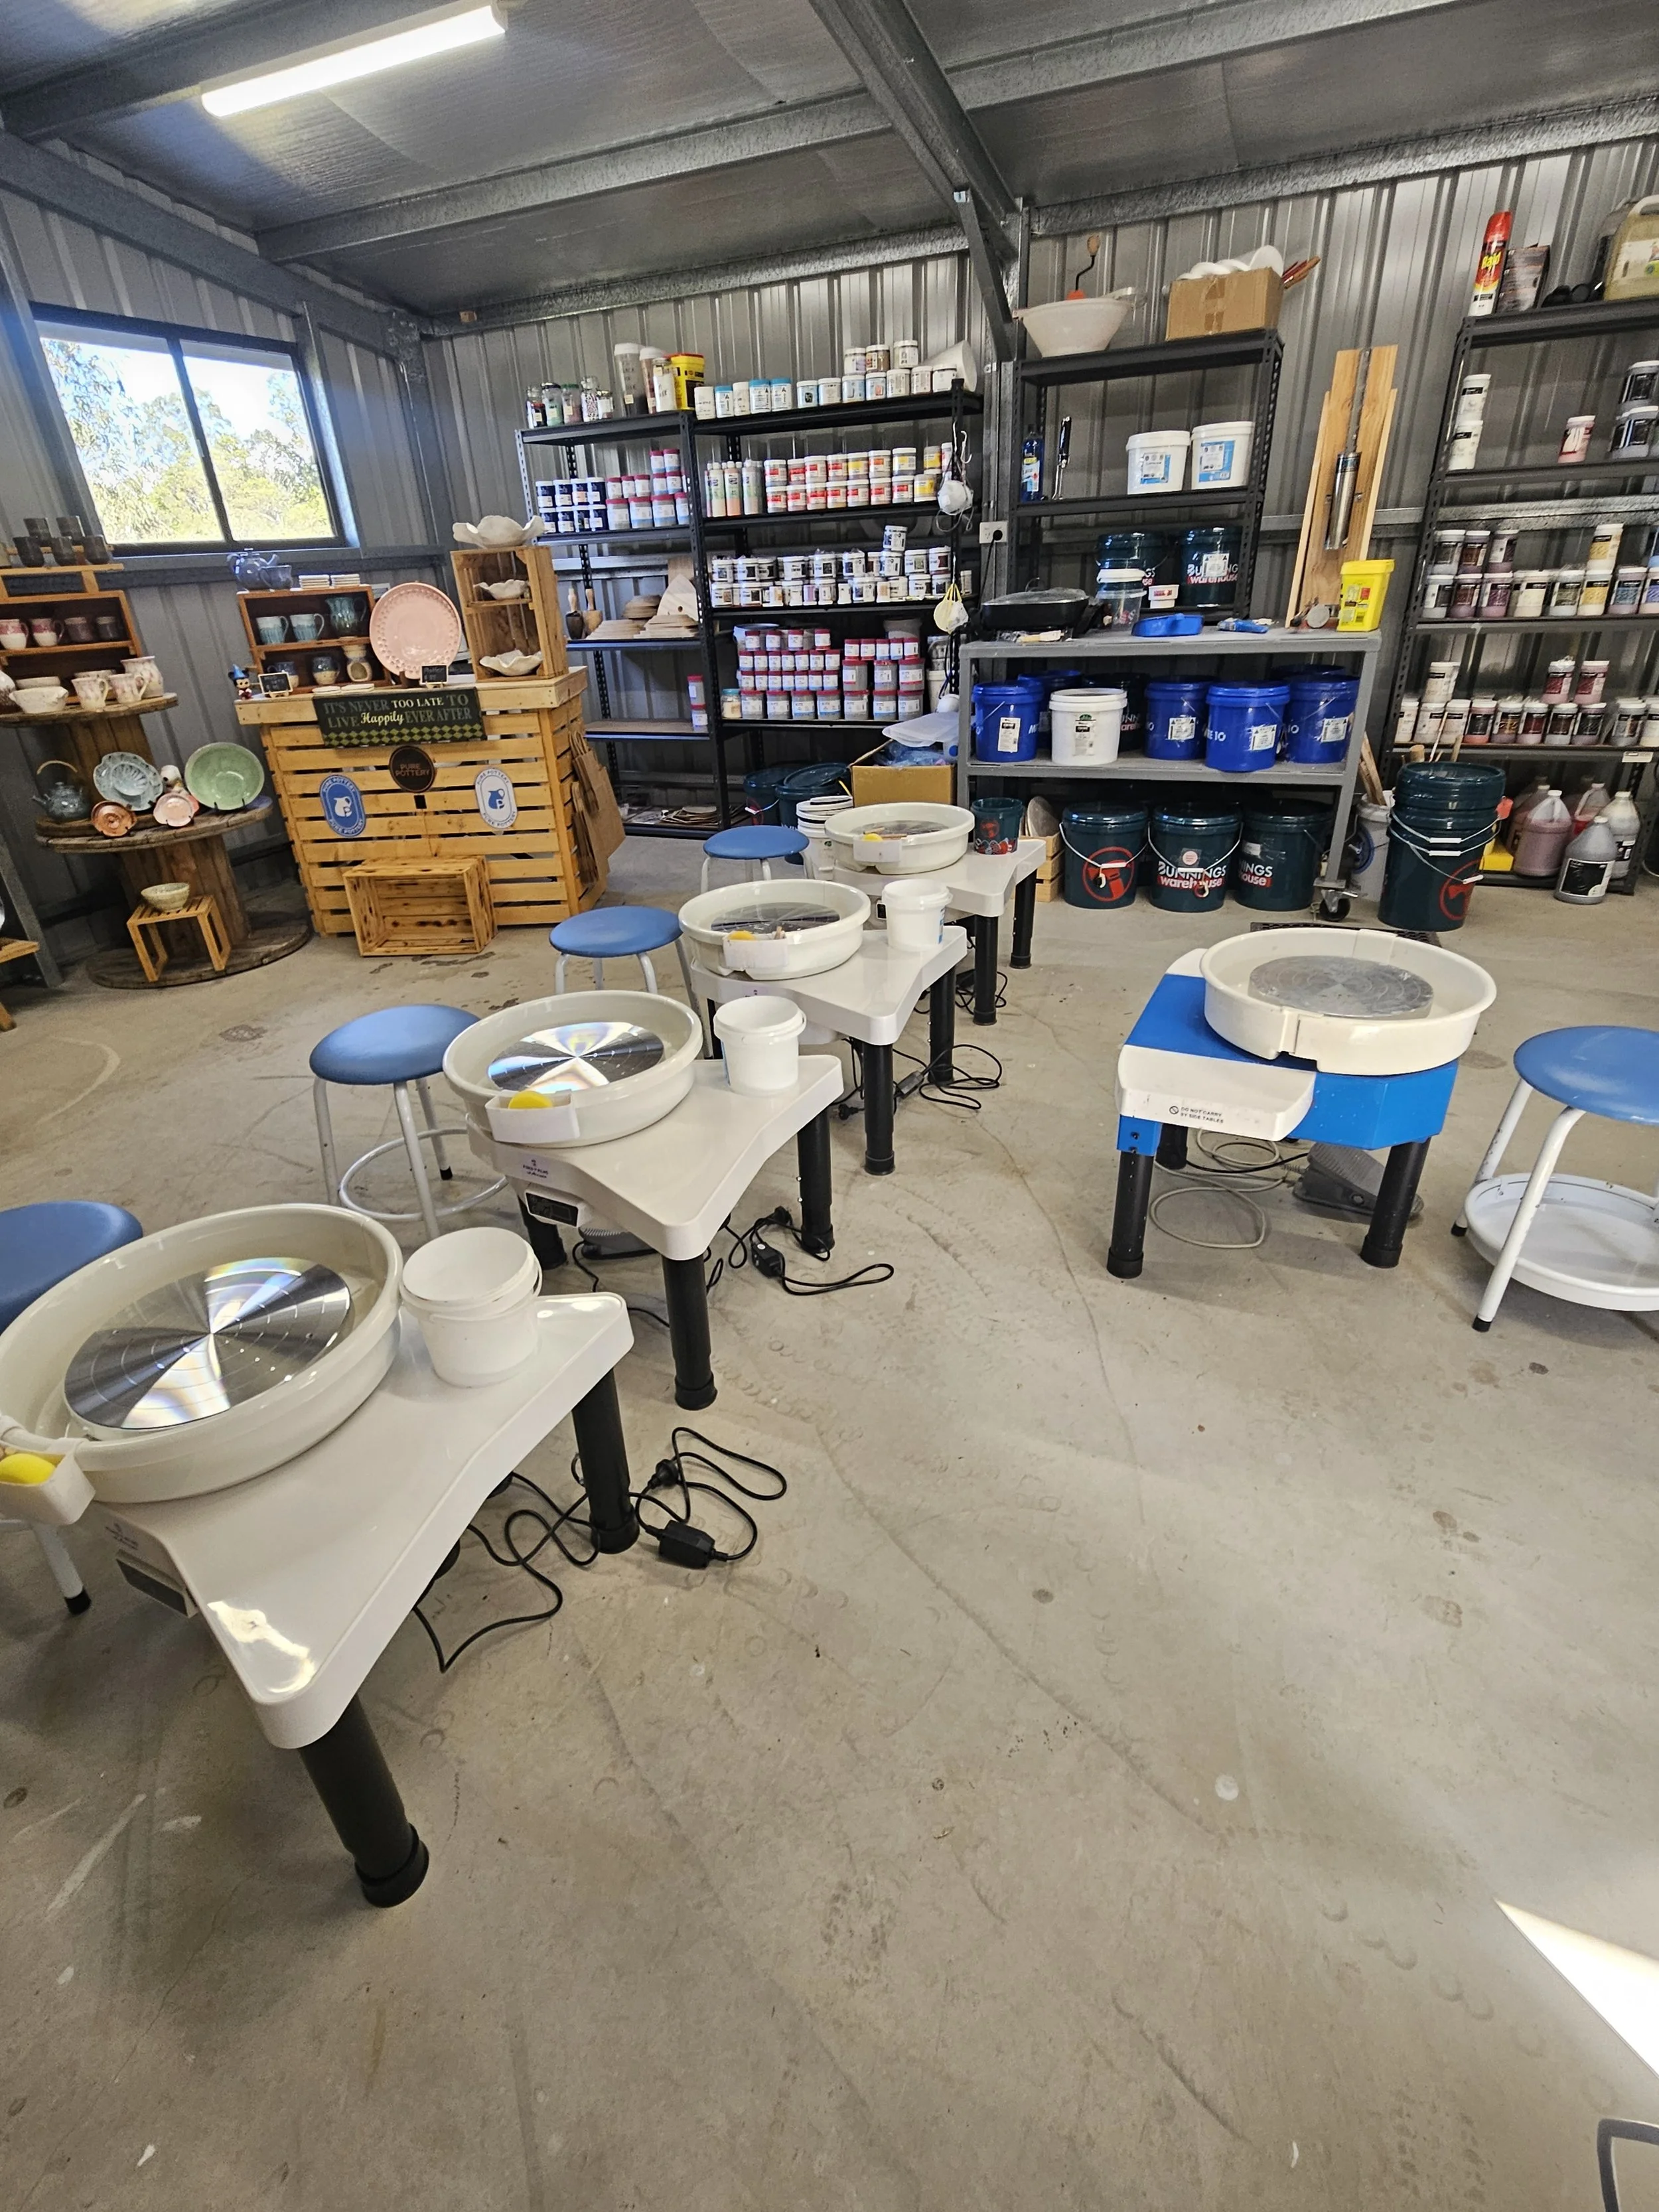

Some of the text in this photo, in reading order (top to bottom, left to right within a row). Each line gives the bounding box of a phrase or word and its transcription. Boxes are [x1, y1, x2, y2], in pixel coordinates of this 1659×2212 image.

[323, 694, 469, 714] IT'S NEVER TOO LATE TO
[328, 707, 472, 729] LIVE Happily EVER AFTER
[1160, 875, 1222, 889] warehuse
